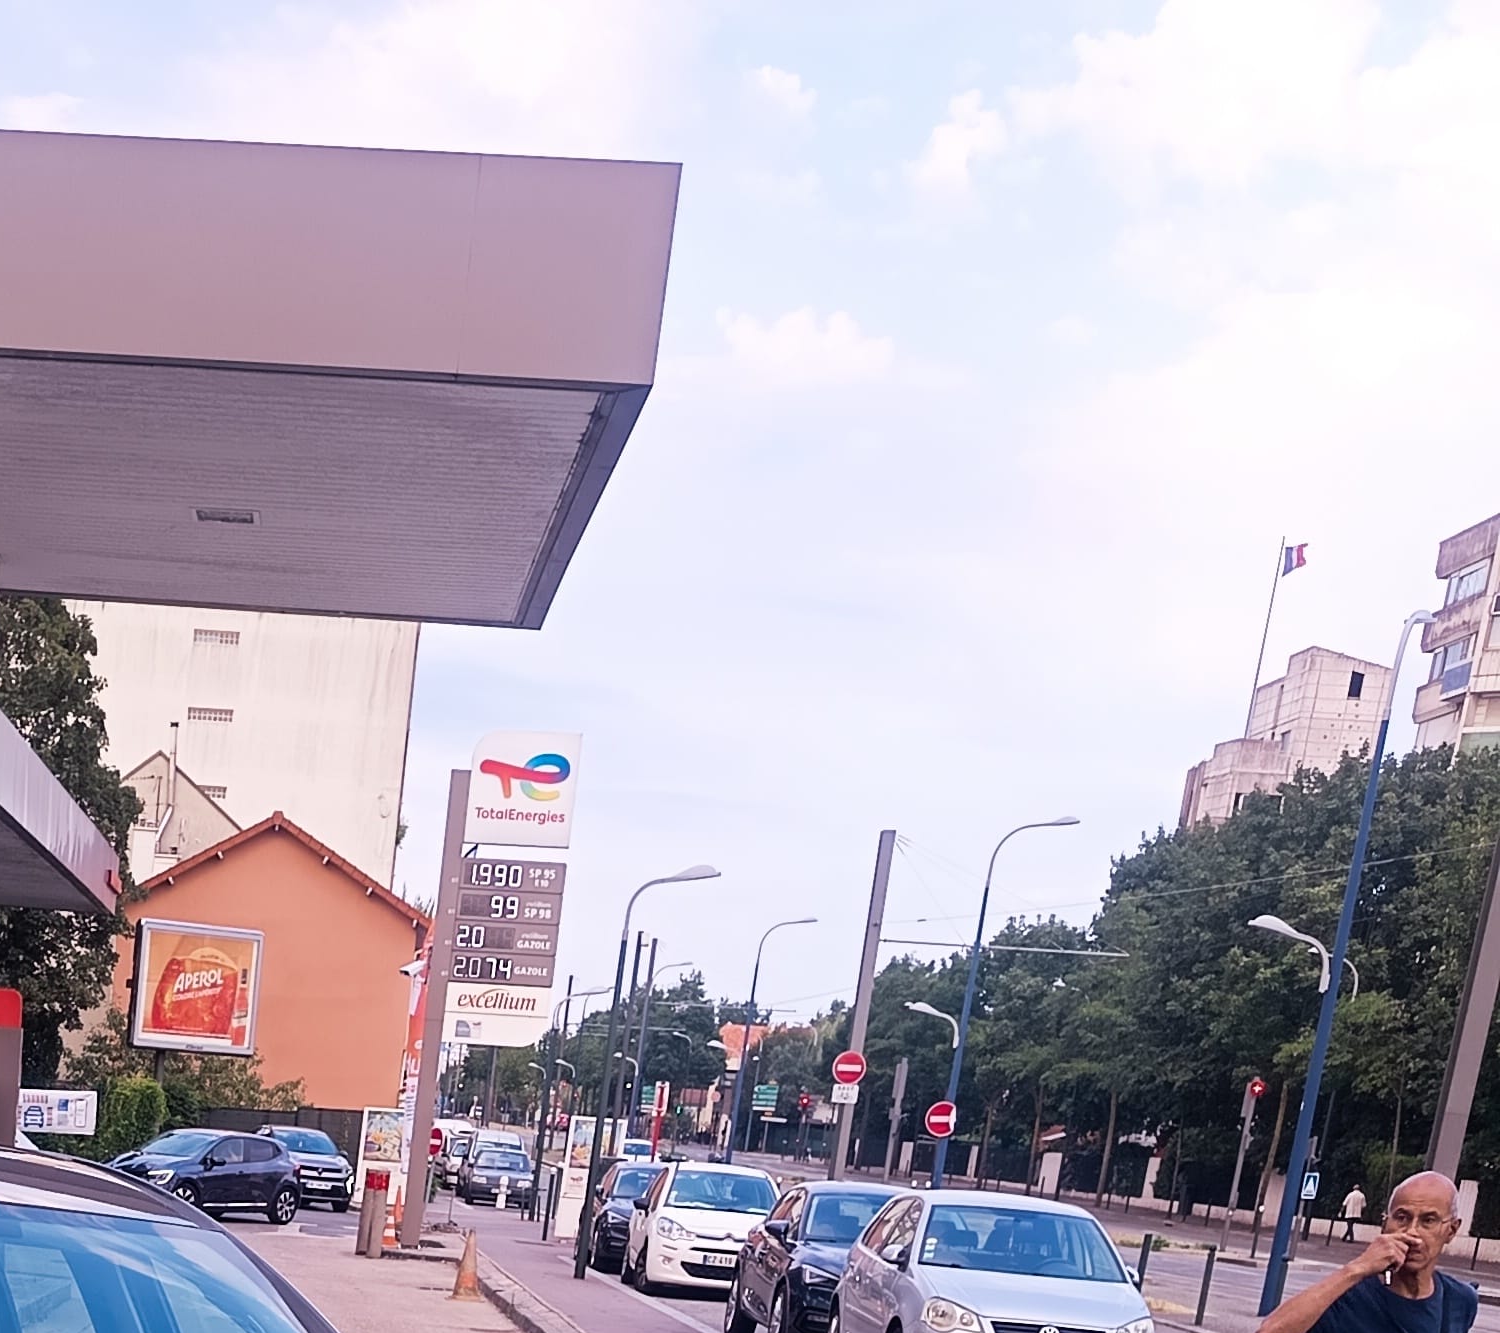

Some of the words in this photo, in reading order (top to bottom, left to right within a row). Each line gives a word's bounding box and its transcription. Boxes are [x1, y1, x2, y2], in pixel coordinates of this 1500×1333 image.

[475, 806, 566, 825] TotalEnergies
[528, 868, 542, 879] SP
[543, 869, 556, 880] 95
[523, 907, 538, 919] SP
[516, 940, 552, 950] GAZOLE
[513, 966, 549, 977] GAZOLE
[173, 968, 224, 993] APEROL
[457, 991, 537, 1011] excellium
